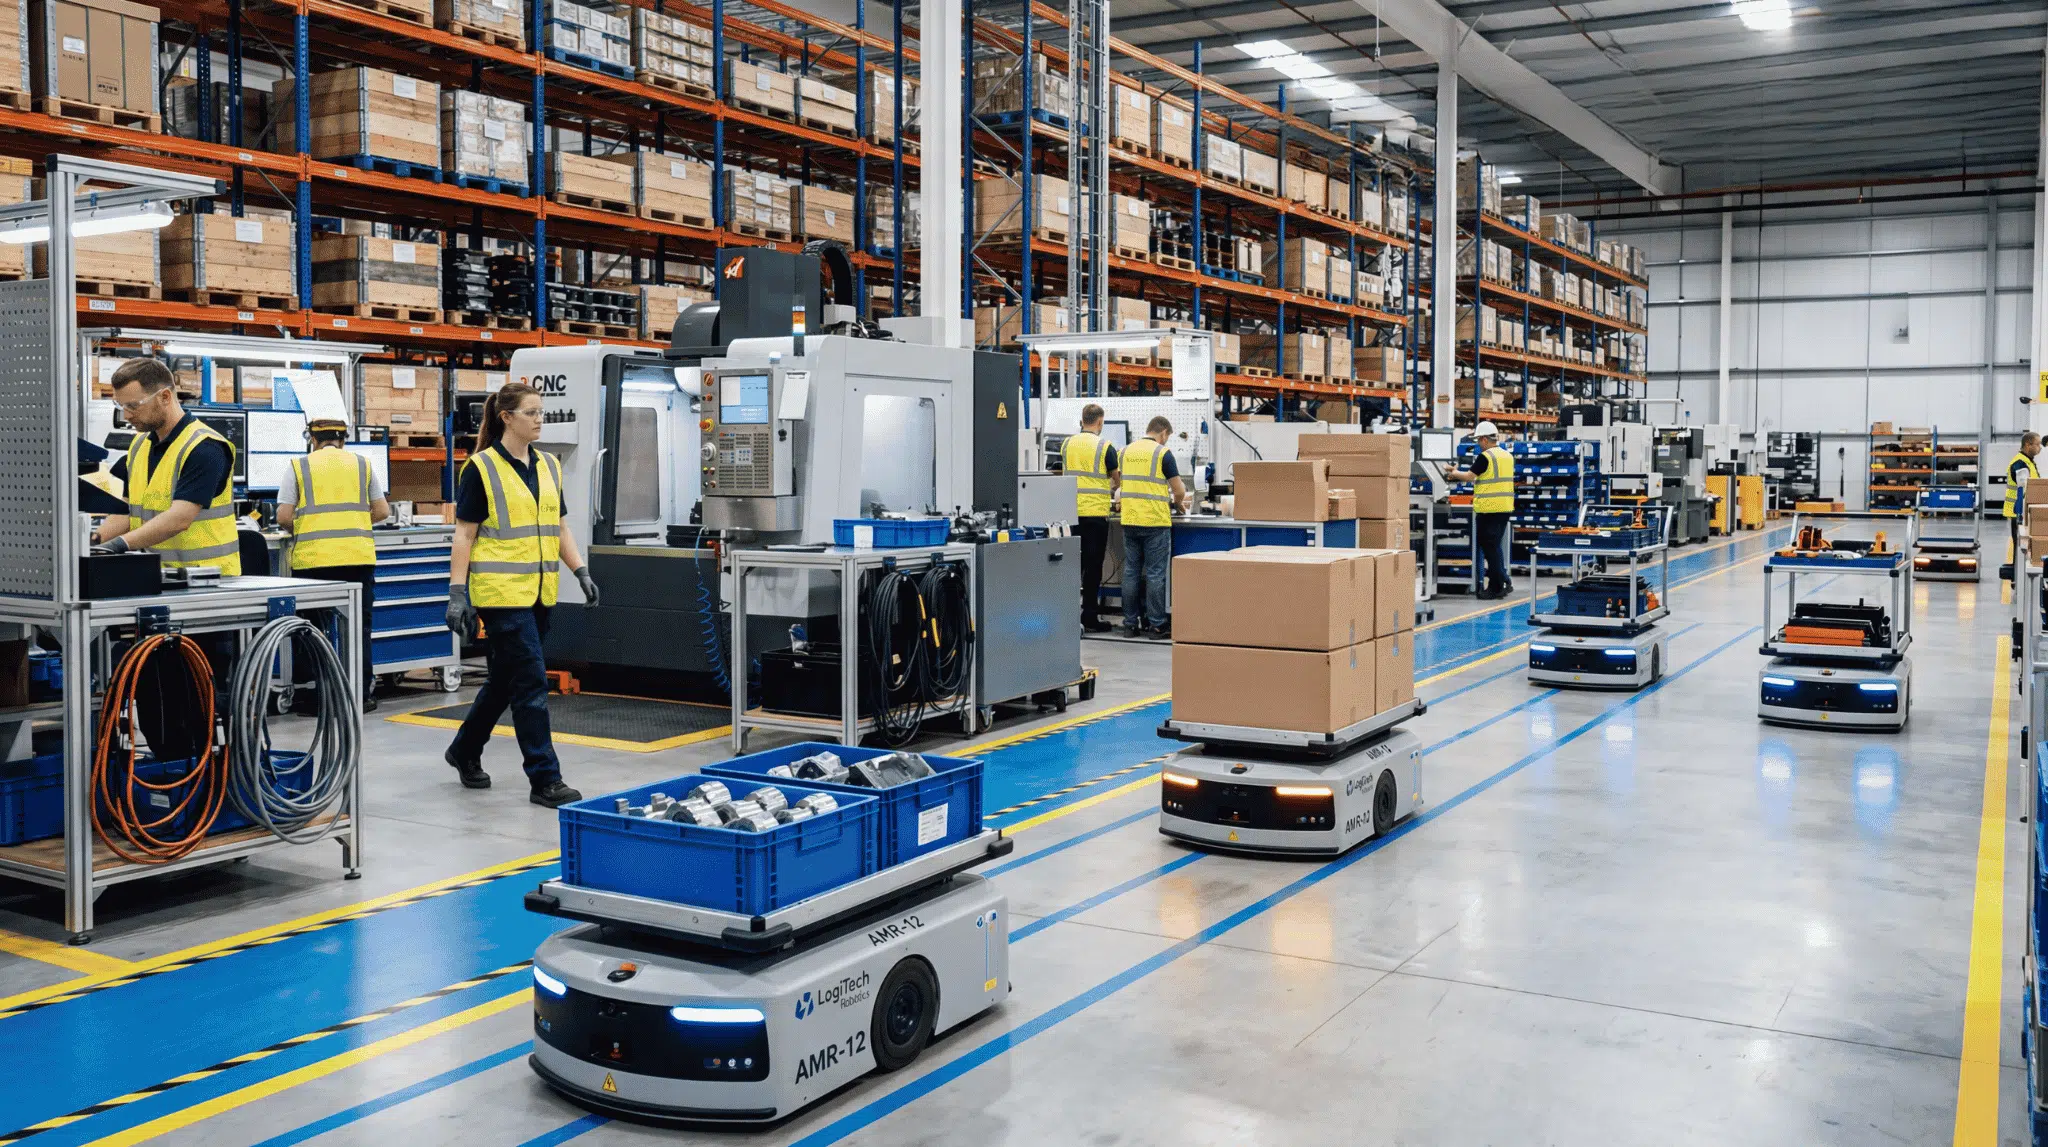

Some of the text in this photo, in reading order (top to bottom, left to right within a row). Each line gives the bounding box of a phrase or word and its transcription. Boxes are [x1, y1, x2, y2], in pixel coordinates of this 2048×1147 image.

[532, 374, 567, 391] CNC
[868, 915, 924, 946] AMR-12
[818, 970, 870, 1005] LogiTech
[795, 1030, 866, 1084] AMR-12
